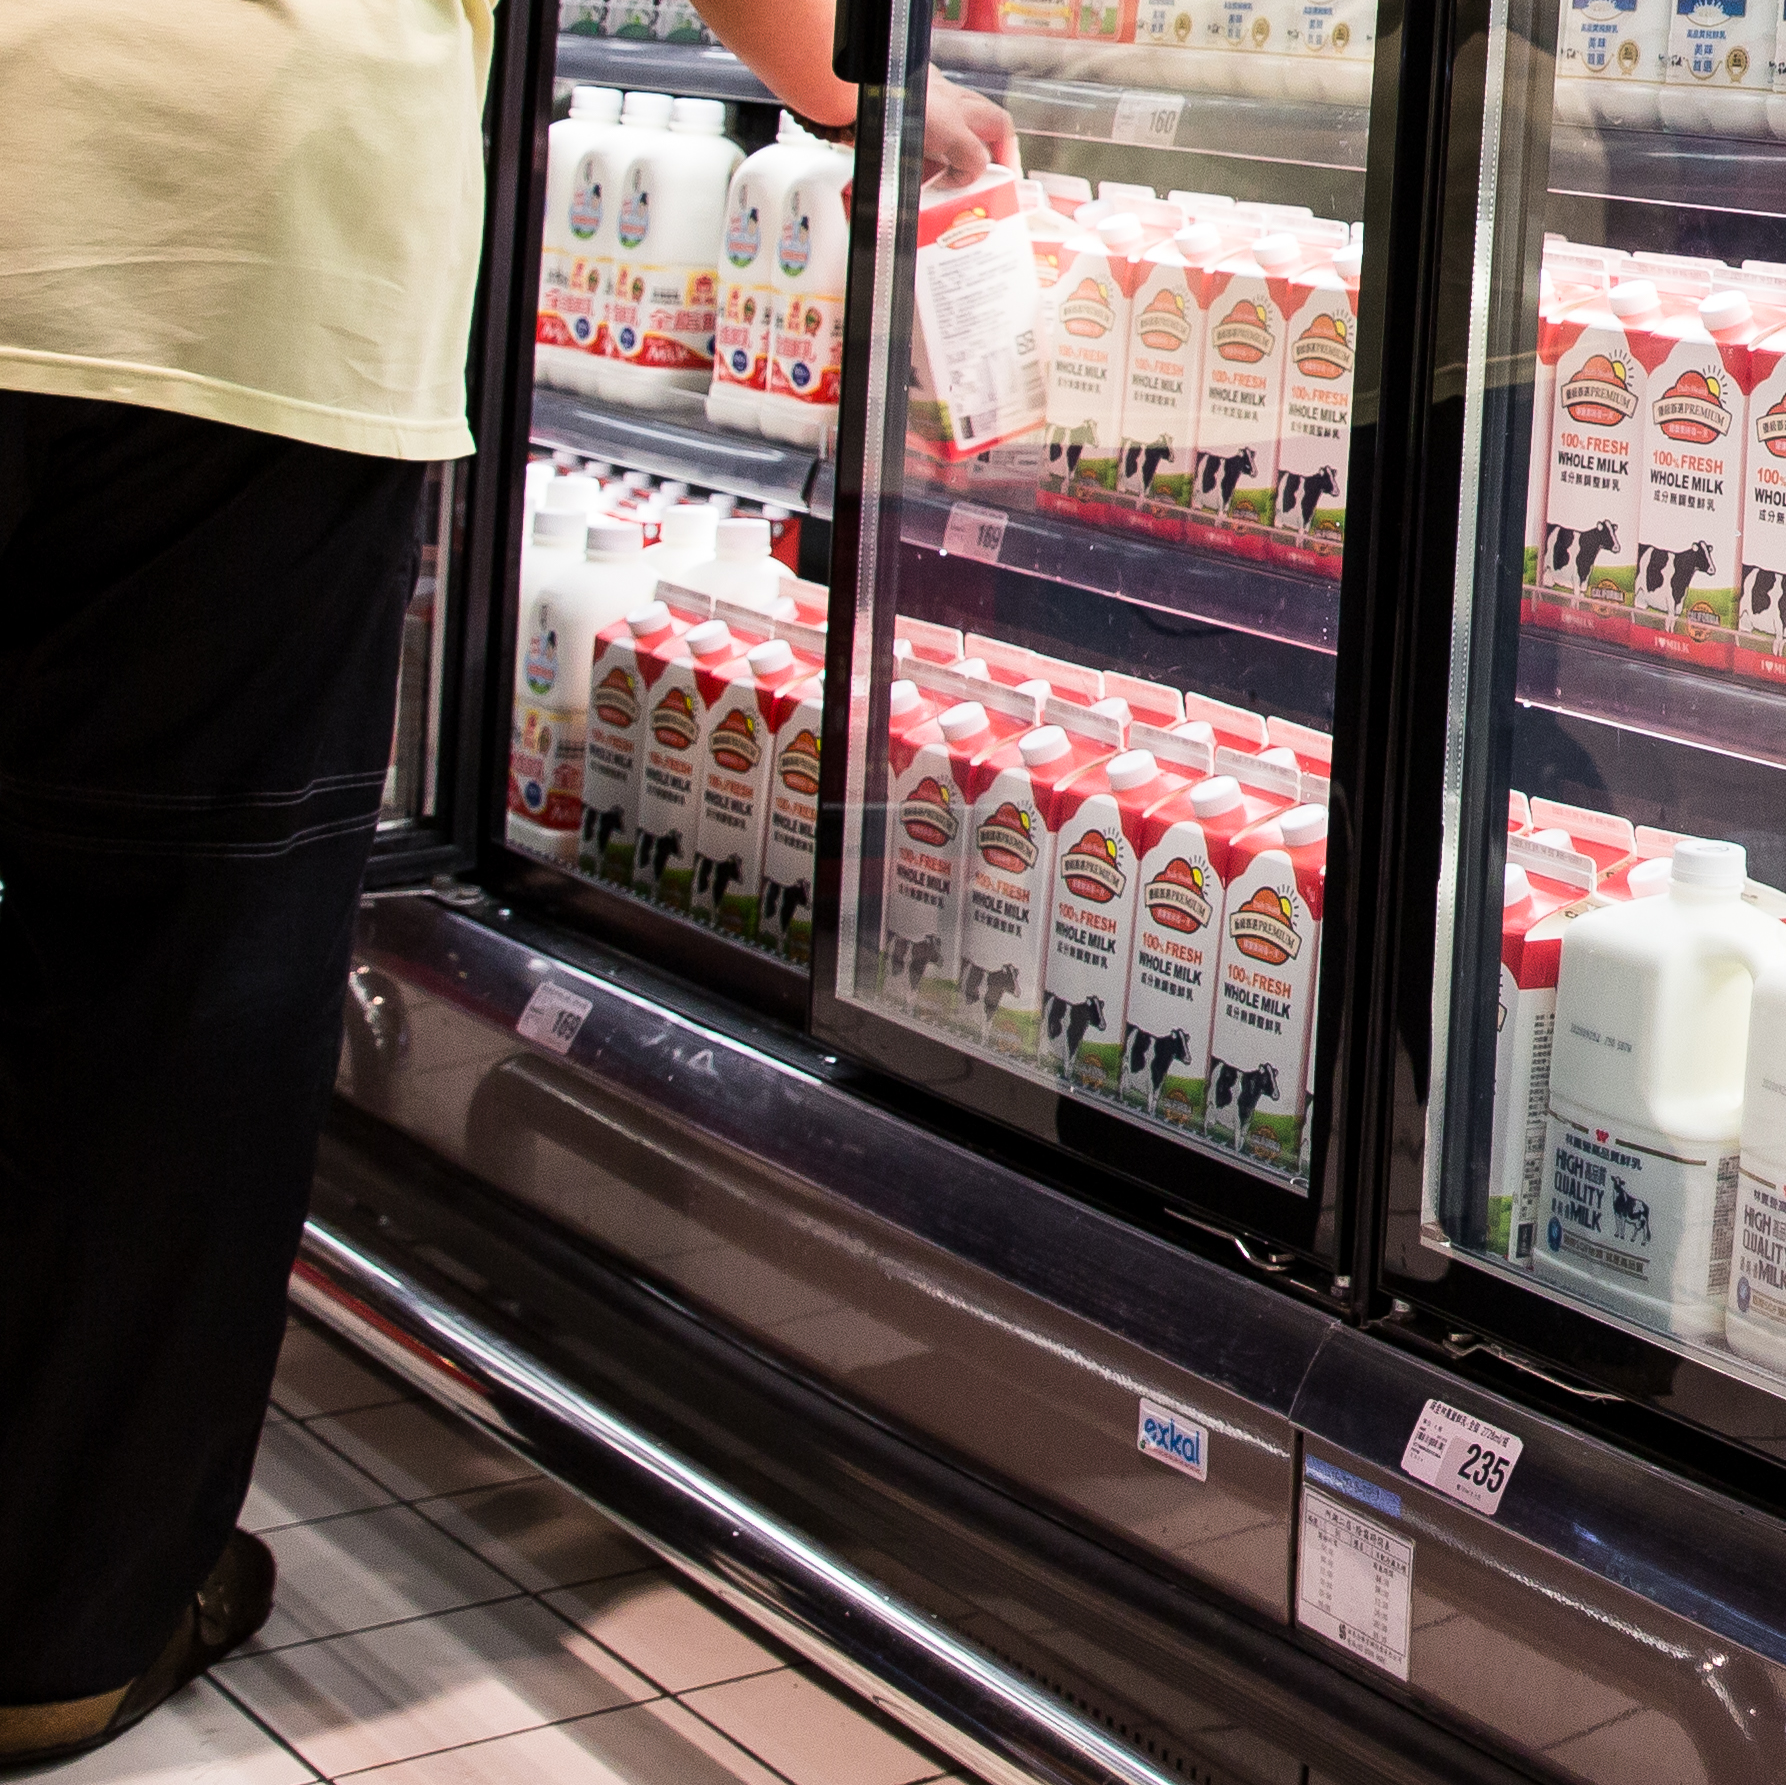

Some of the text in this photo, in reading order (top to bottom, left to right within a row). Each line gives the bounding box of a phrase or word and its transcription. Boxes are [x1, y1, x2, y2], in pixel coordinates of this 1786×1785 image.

[1149, 109, 1176, 134] 160
[1757, 468, 1786, 487] 100%
[977, 526, 1000, 551] 169
[1253, 973, 1291, 999] FRESH
[1225, 982, 1291, 1020] WHOLE MILK
[552, 1010, 579, 1043] 169
[1144, 1419, 1200, 1465] exkal
[1458, 1444, 1510, 1493] 235
